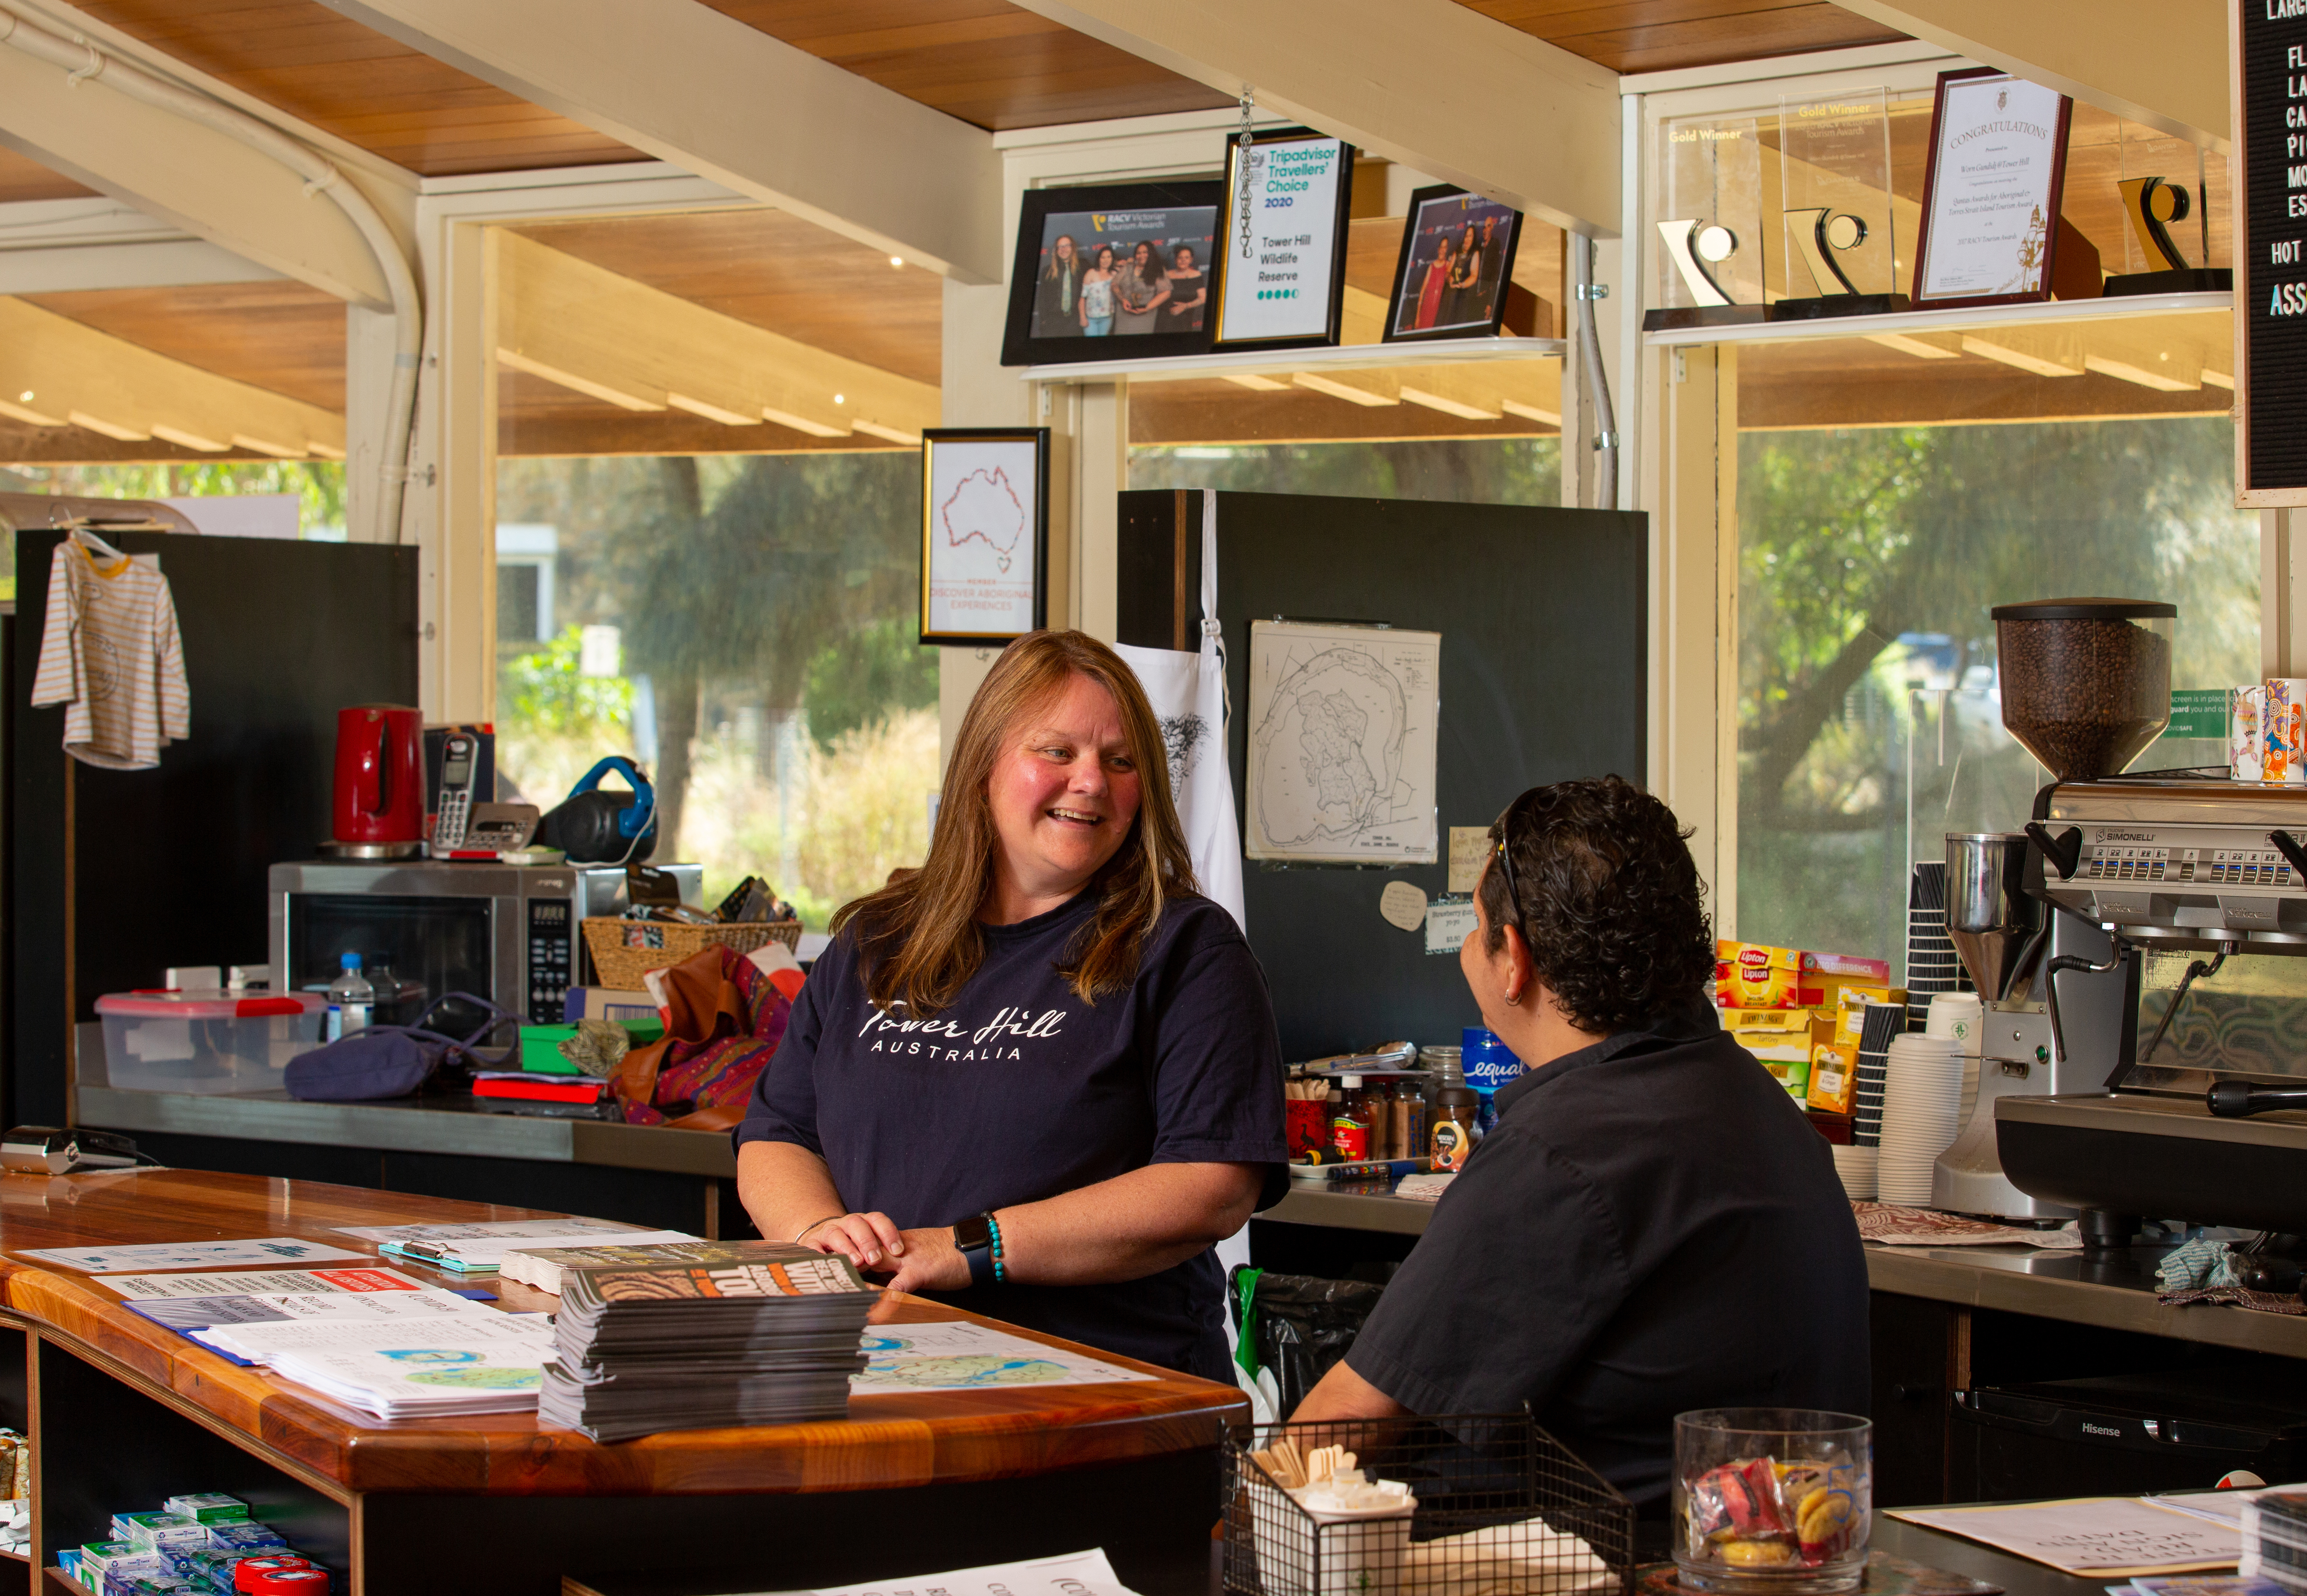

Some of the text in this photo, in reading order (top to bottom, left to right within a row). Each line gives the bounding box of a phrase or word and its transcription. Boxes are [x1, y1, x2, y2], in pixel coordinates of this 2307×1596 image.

[2267, 0, 2307, 20] LARG
[1799, 104, 1871, 118] Gold Winner
[1668, 129, 1741, 143] Gold Winner
[1836, 127, 1864, 136] Awards
[1950, 121, 2047, 149] CONGRATULATIONS
[1269, 147, 1336, 165] Tripadvisor
[2019, 157, 2030, 166] Hill
[1266, 179, 1309, 192] Choice
[1998, 190, 2024, 200] Aboriginal
[1265, 197, 1293, 208] 2020
[1995, 202, 2016, 211] Tourism
[2016, 199, 2033, 208] Award
[1262, 235, 1311, 247] Tower Hill
[2271, 240, 2301, 264] HOT
[1261, 253, 1298, 265] Wildlife
[1258, 271, 1298, 282] Reserve
[931, 588, 1034, 599] DISCOVER ABORIGINAL
[950, 599, 1012, 611] EXPERIENCES
[1740, 952, 1766, 964] Lipton
[1830, 962, 1873, 974] DIFFERENCE
[1744, 969, 1768, 980] Lipton
[859, 999, 1066, 1044] Tower Hill
[1748, 1014, 1779, 1023] TWININGS
[871, 1040, 1020, 1061] AUSTRALIA
[1463, 1059, 1525, 1085] equal
[258, 1276, 290, 1285] CONTACT
[348, 1272, 404, 1288] ATTENTION
[306, 1282, 340, 1292] SOMEONE
[188, 1300, 224, 1309] SHOP
[217, 1299, 256, 1310] WALKS
[269, 1296, 314, 1310] DETAILS
[295, 1296, 341, 1309] RECORD
[345, 1294, 390, 1308] CONTACT
[397, 1294, 464, 1312] (COVID-19)
[2083, 1423, 2120, 1437] Hisense
[2051, 1530, 2145, 1541] DATE
[2119, 1532, 2203, 1545] SIGN
[2139, 1547, 2241, 1559] STAFF
